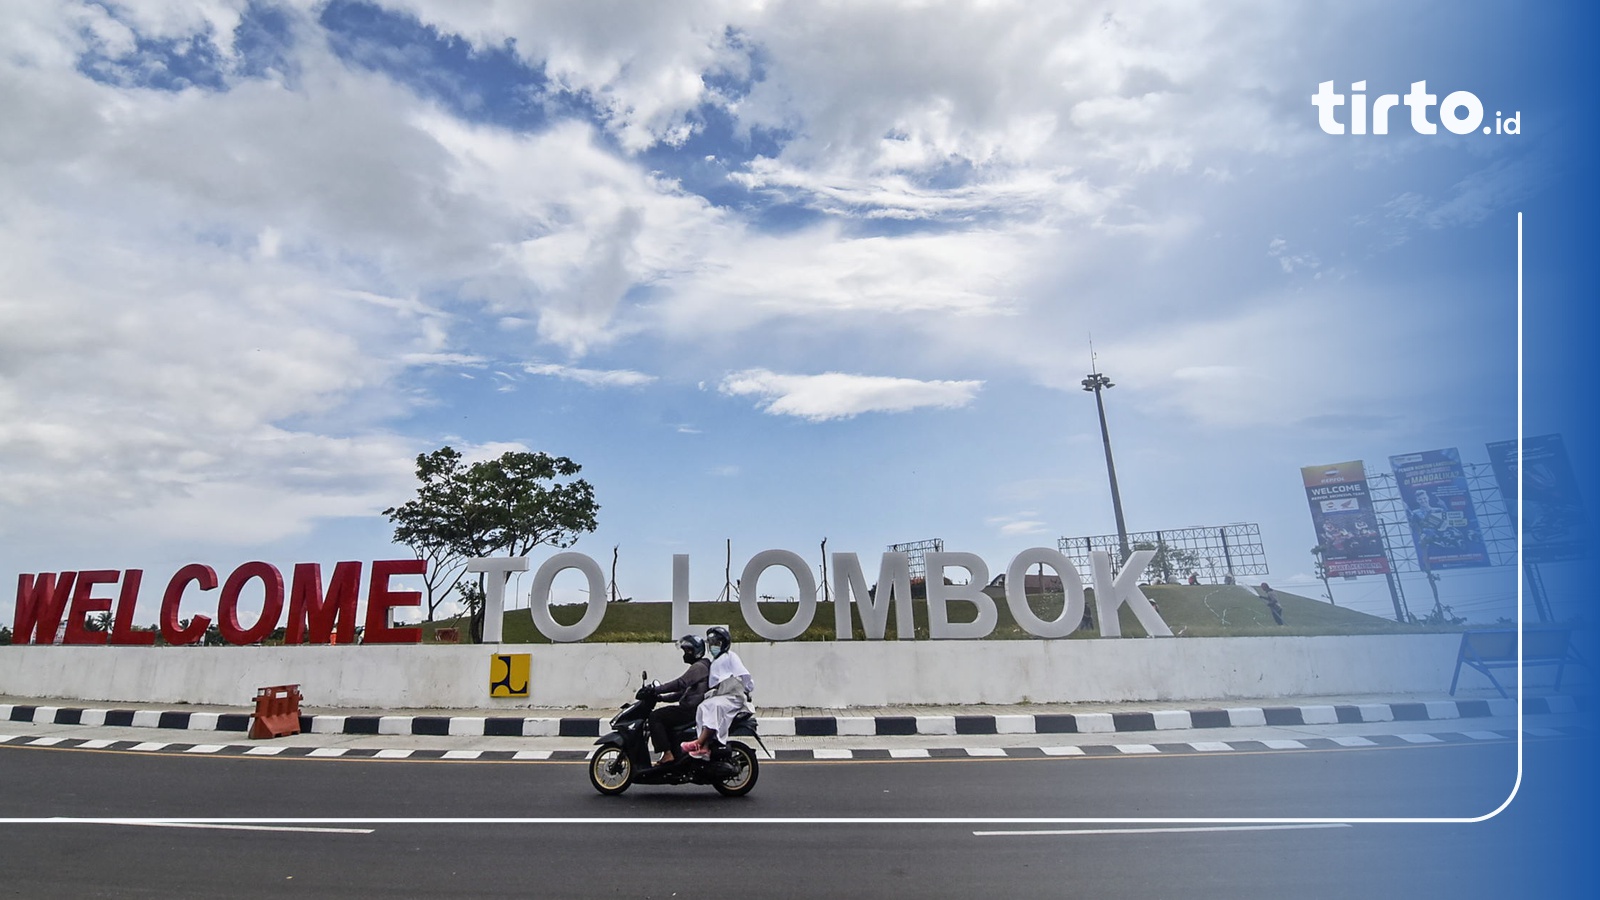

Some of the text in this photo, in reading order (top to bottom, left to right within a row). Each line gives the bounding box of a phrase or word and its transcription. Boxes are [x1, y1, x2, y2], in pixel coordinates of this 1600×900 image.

[1311, 484, 1361, 496] WELCOME
[12, 547, 1174, 645] WELCOME TO LOMBOK
